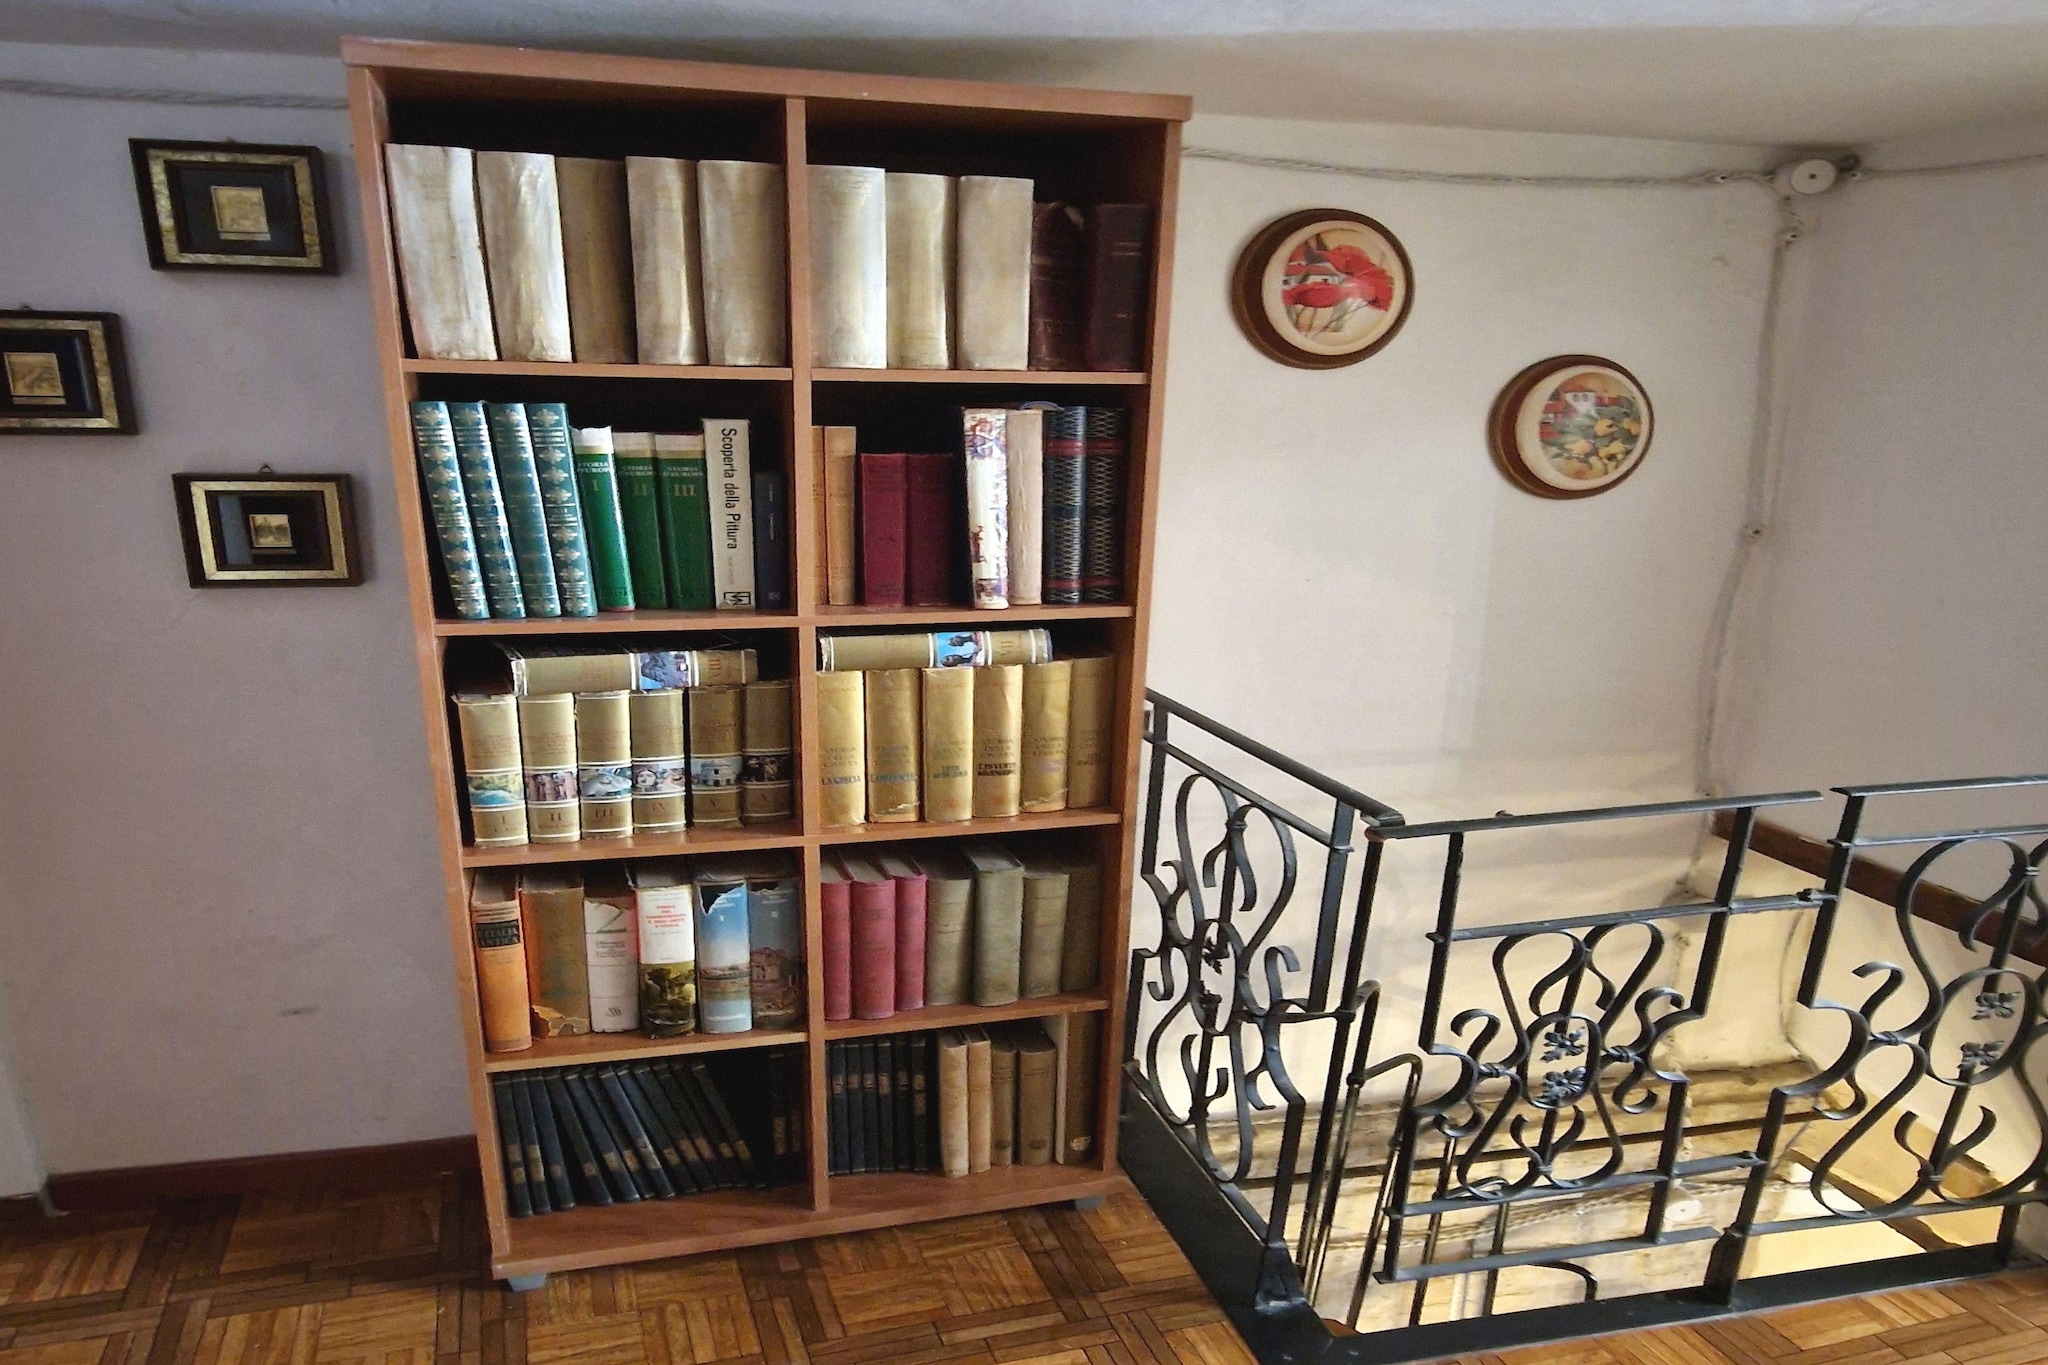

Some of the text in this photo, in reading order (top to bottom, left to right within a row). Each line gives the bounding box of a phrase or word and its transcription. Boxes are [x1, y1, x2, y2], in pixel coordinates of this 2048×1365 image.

[721, 427, 738, 479] Scoperta
[673, 484, 697, 497] III
[723, 482, 741, 509] della
[726, 513, 742, 550] Pittura
